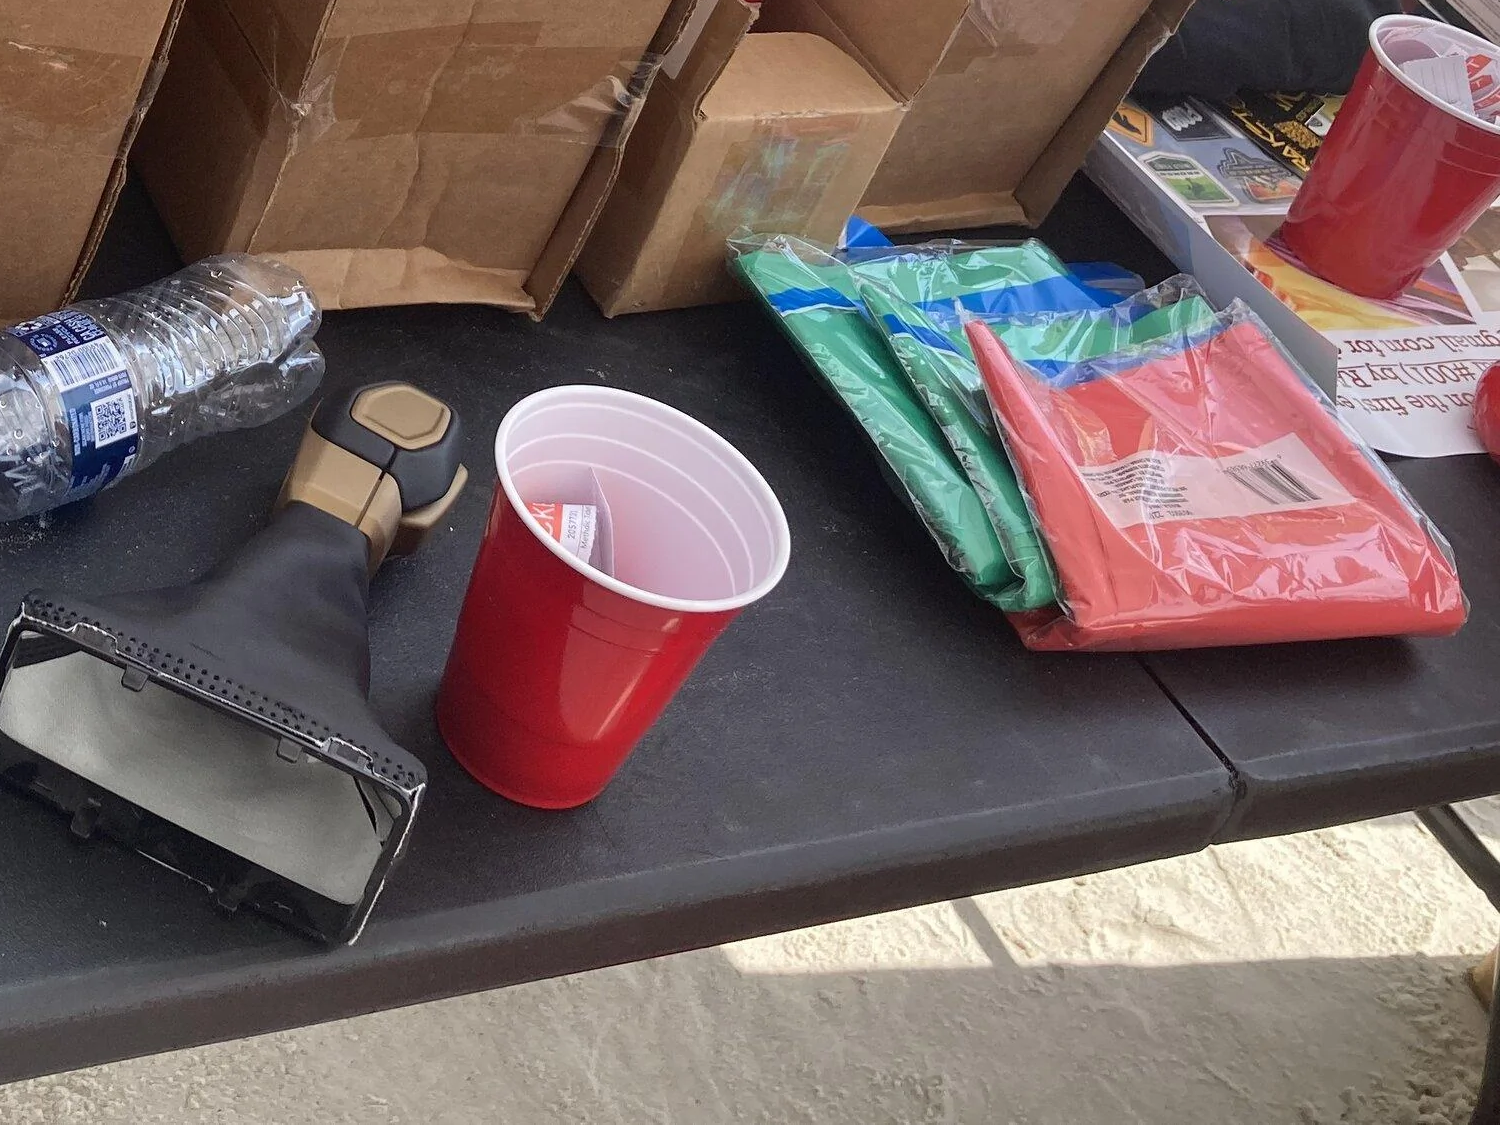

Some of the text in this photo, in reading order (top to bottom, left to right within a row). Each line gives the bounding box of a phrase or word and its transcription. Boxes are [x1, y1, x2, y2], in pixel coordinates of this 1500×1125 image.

[1345, 330, 1500, 357] gmail.com for
[1365, 363, 1407, 385] by
[1353, 396, 1408, 416] first
[1405, 394, 1449, 413] the
